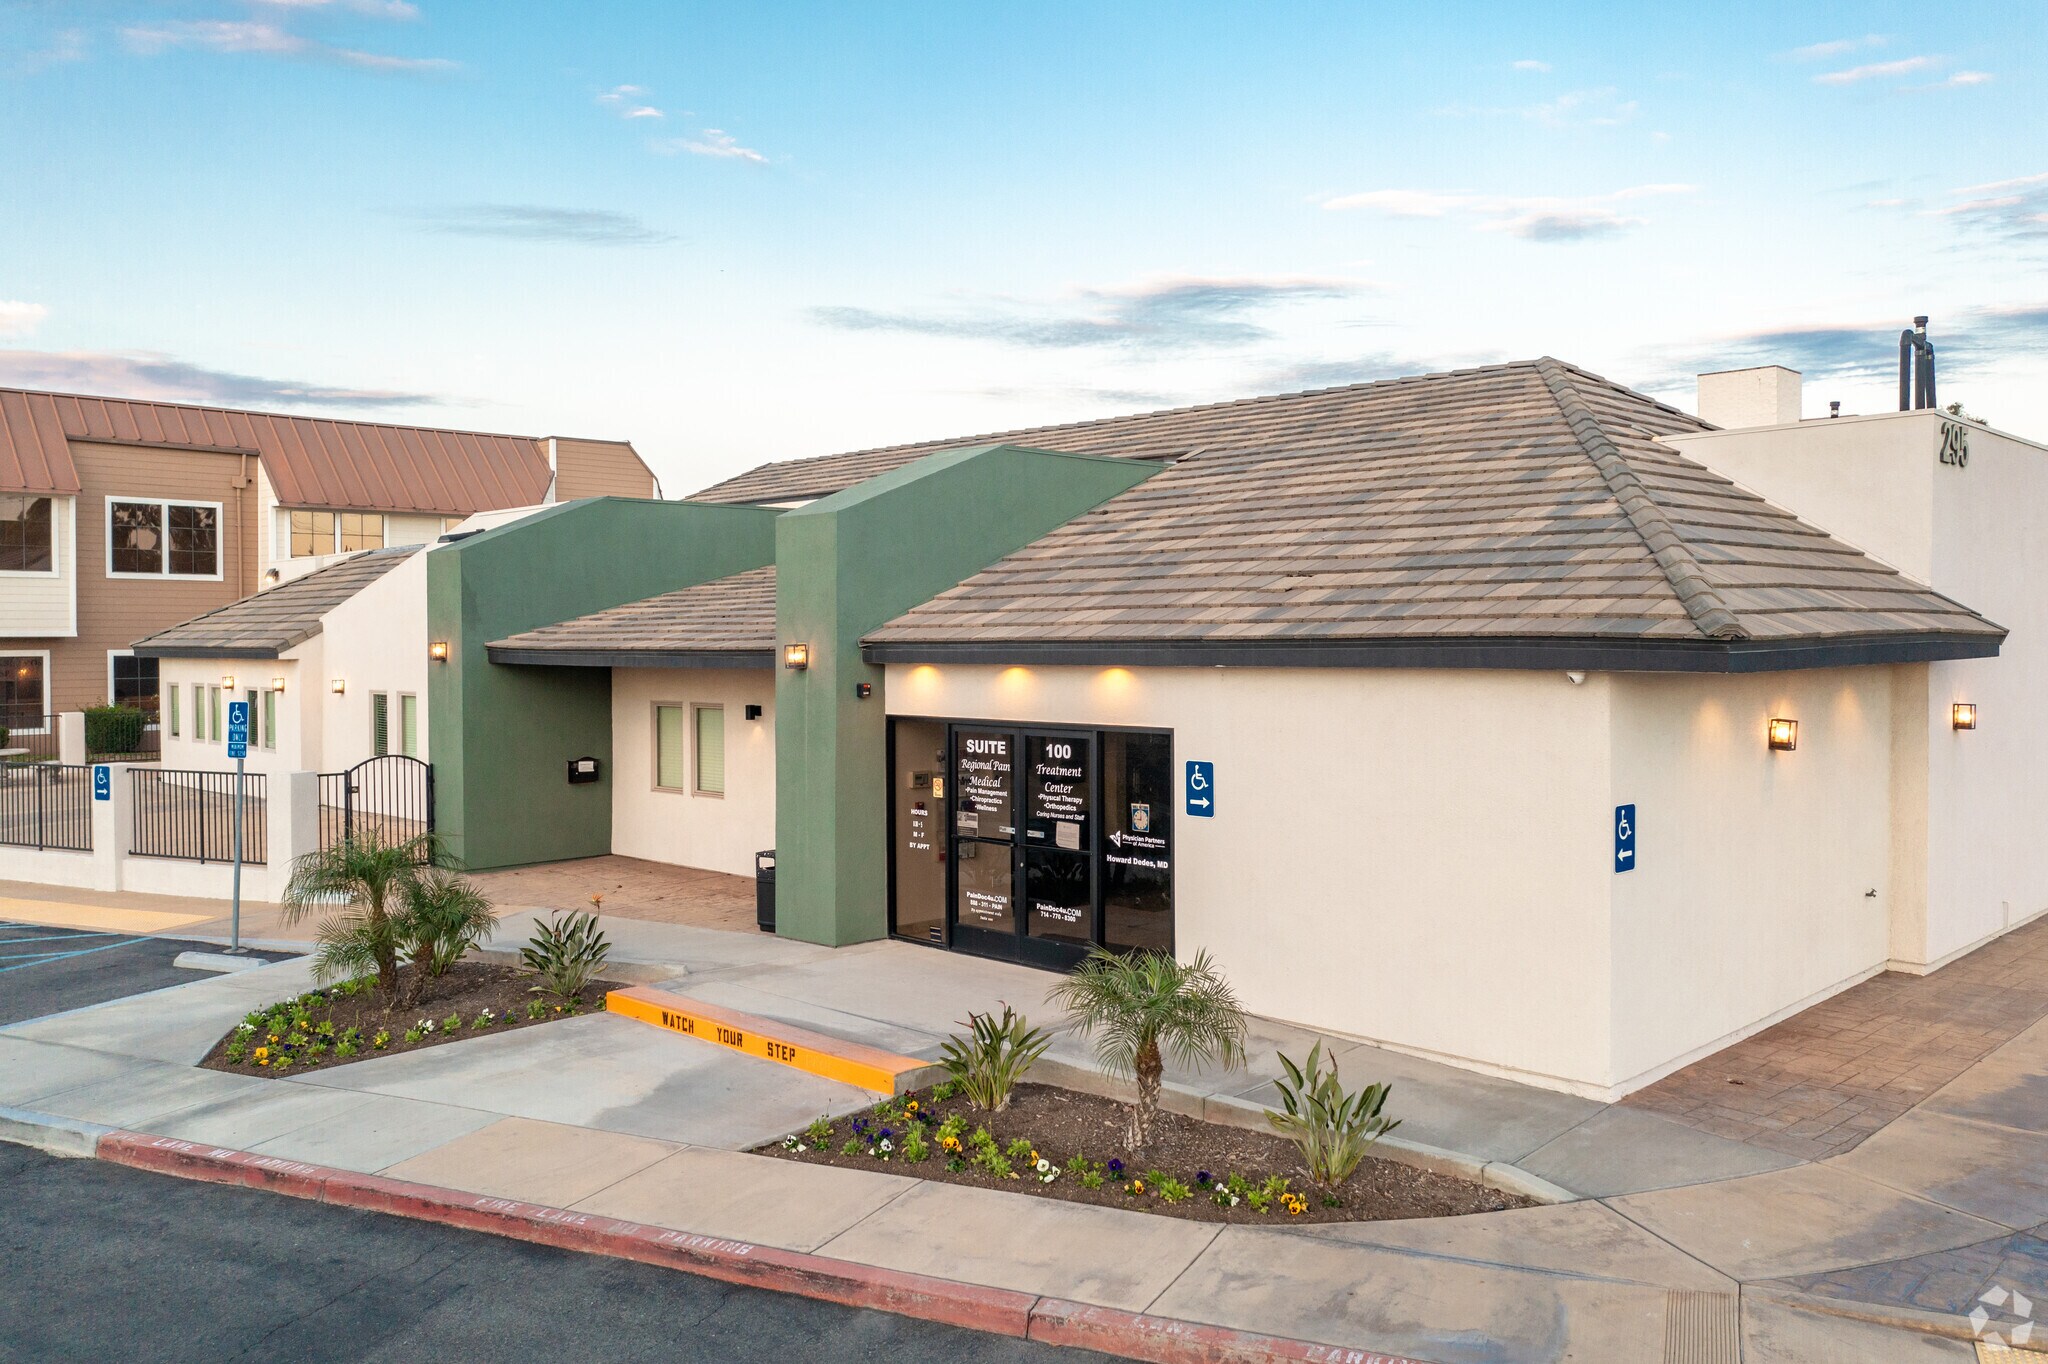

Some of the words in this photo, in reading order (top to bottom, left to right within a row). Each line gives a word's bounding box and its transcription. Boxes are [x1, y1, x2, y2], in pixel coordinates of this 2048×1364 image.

[1940, 421, 1969, 468] 295
[966, 739, 1006, 755] SUITE
[1046, 744, 1071, 759] 100
[961, 758, 993, 772] Regional
[1036, 763, 1082, 777] Treatment
[969, 775, 1002, 788] Medical
[1044, 781, 1073, 794] Center
[1061, 794, 1083, 804] Therapy
[1036, 810, 1050, 819] Caring
[1122, 834, 1144, 843] Physician
[1144, 836, 1166, 846] Partners
[1106, 854, 1132, 865] Howard
[1132, 857, 1156, 869] Dedes,
[1156, 860, 1169, 869] MD
[1036, 902, 1082, 917] PainDoc4u.COM
[661, 1010, 694, 1034] WATCH
[716, 1027, 743, 1048] YOUR
[767, 1041, 796, 1062] STEP
